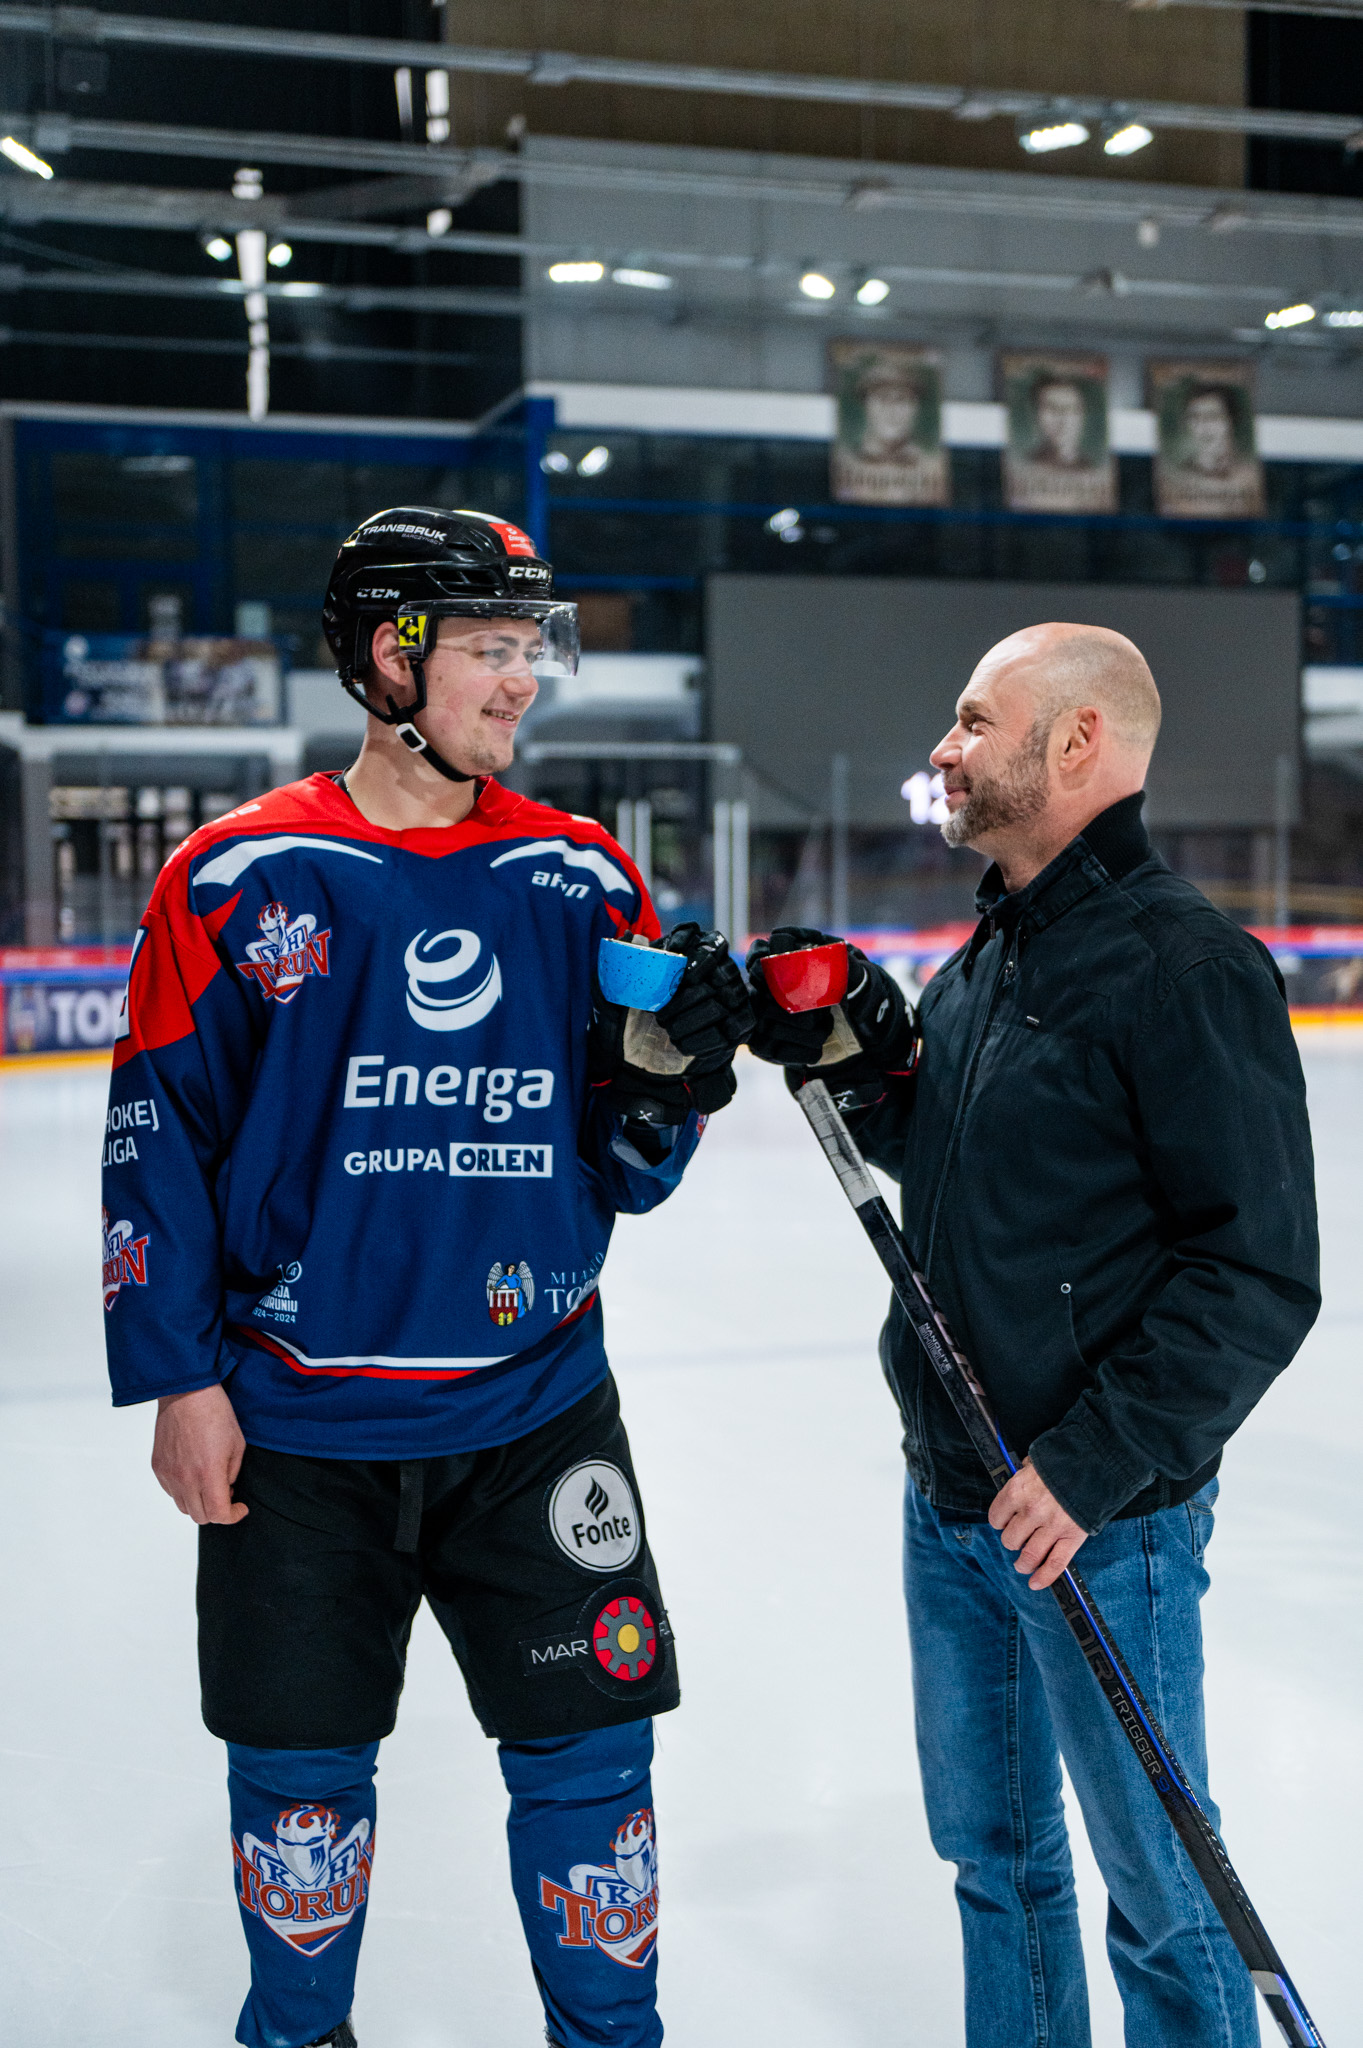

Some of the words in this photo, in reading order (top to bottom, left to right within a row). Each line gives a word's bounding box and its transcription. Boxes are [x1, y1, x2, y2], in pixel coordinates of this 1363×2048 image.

[363, 523, 447, 541] TRANSBRUK
[508, 566, 548, 579] CCM
[357, 588, 400, 598] CCM
[343, 1055, 554, 1123] Energa
[343, 1148, 445, 1176] GRUPA
[456, 1147, 545, 1173] ORLEN
[924, 1321, 952, 1373] NANOLITE
[571, 1515, 632, 1549] Fonte
[531, 1639, 589, 1665] MAR
[1111, 1687, 1161, 1775] TRIGGER
